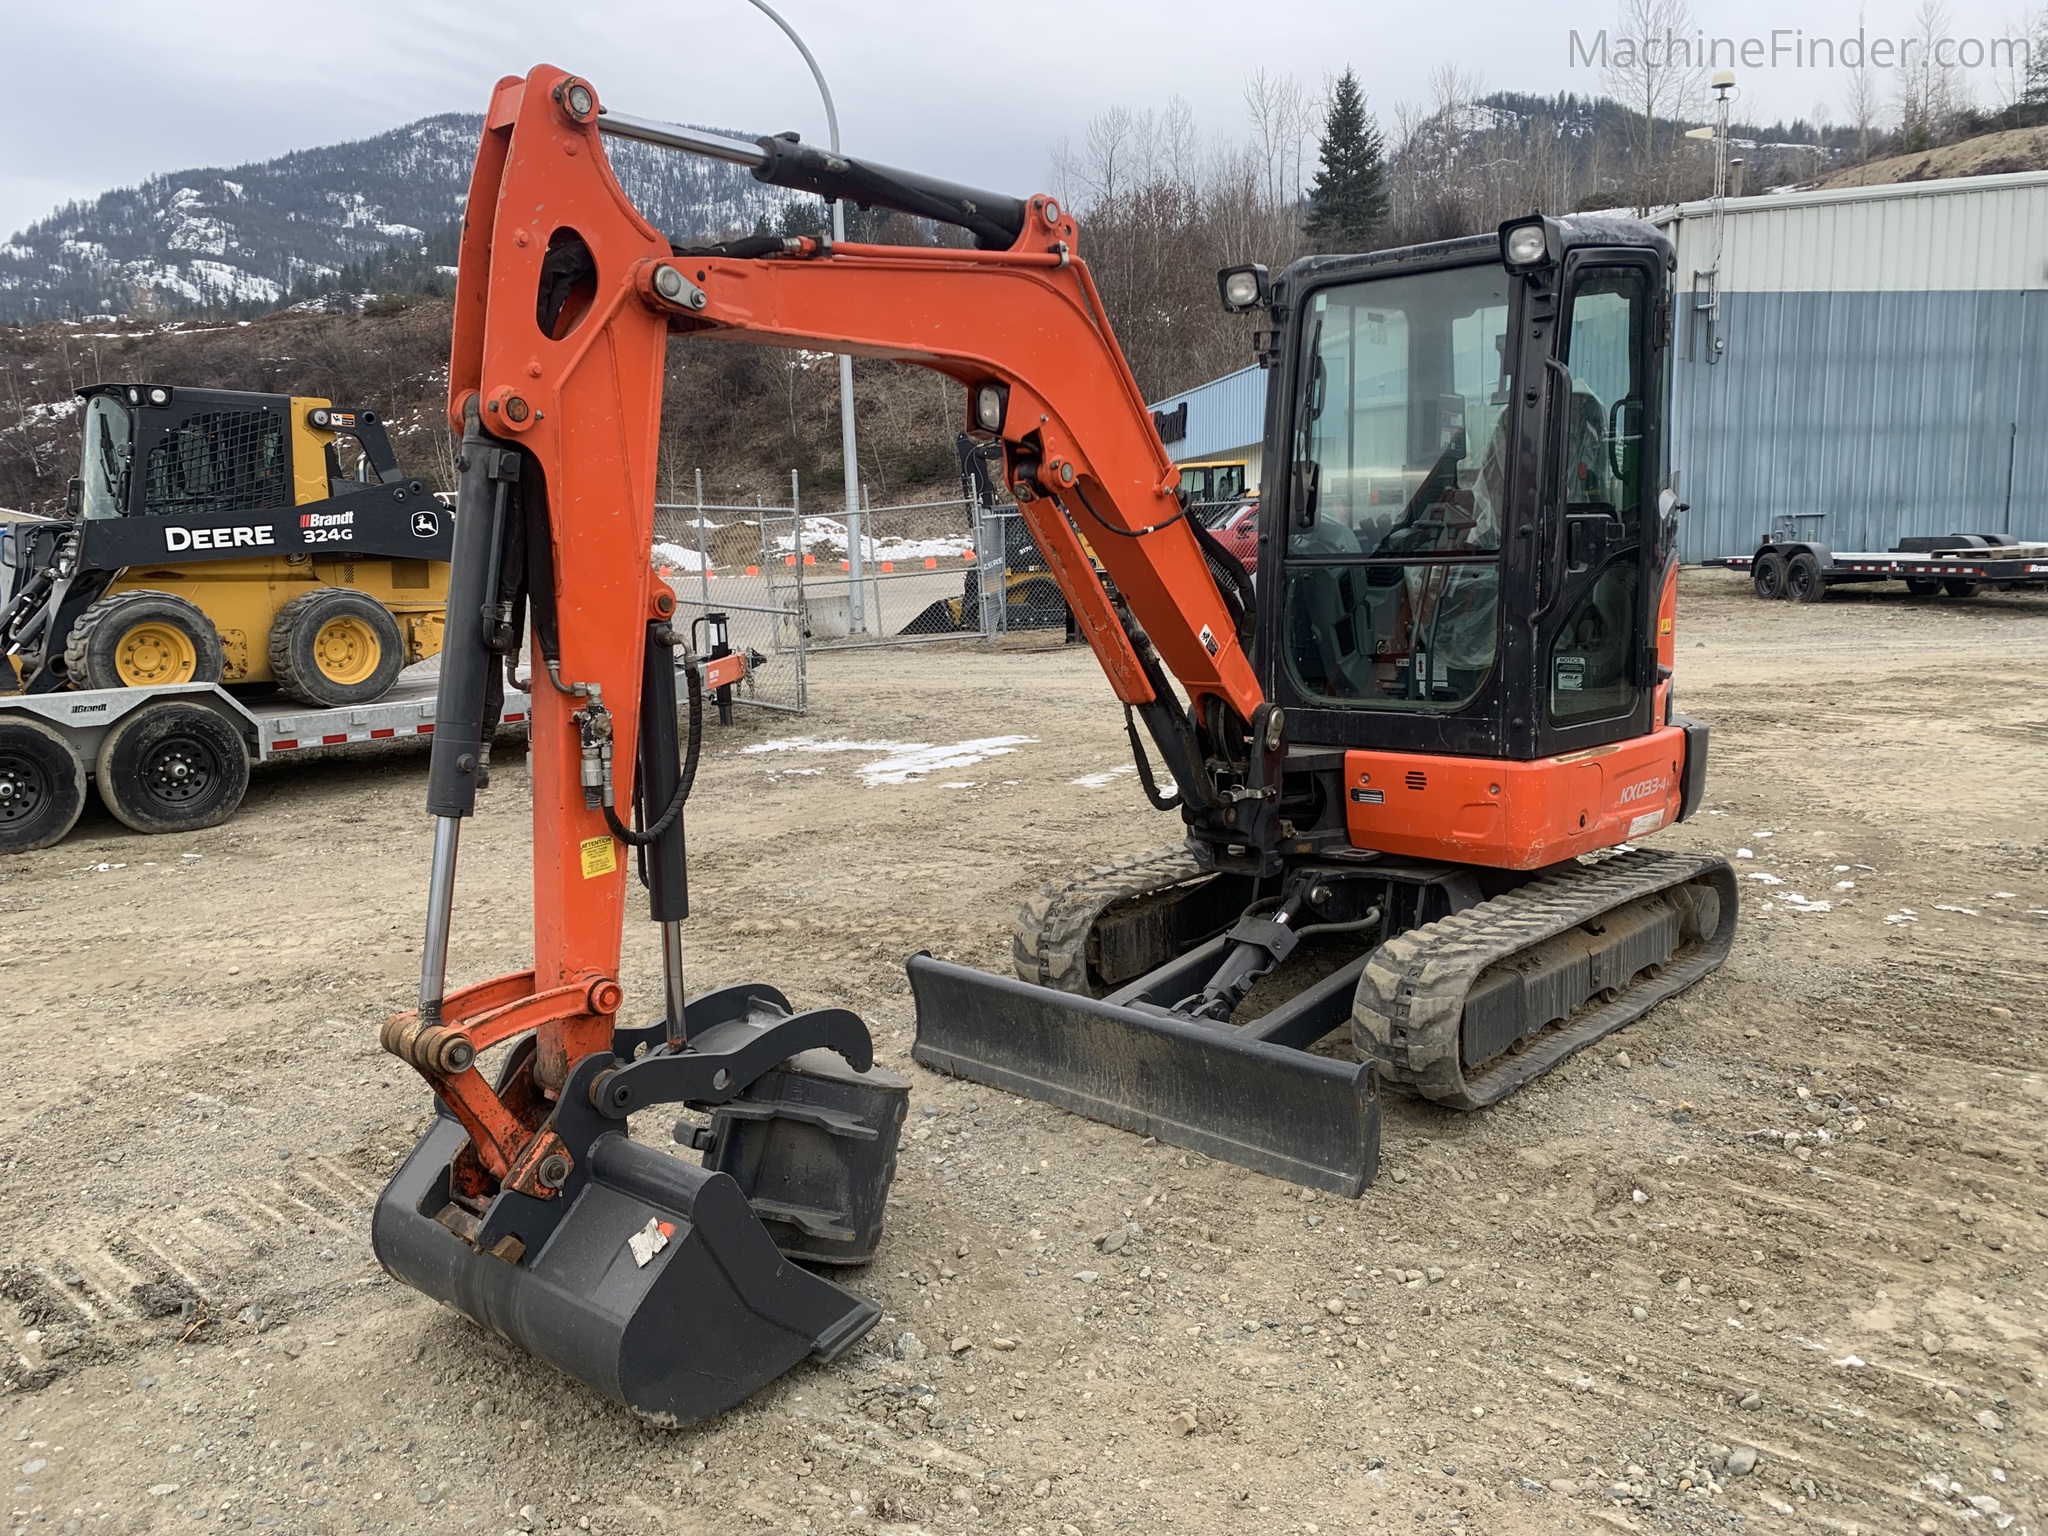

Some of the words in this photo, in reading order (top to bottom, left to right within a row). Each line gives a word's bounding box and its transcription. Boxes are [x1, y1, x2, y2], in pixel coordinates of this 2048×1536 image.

[310, 511, 354, 527] Brandt
[165, 525, 275, 552] DEERE
[303, 528, 353, 543] 324G
[581, 837, 612, 849] ATTENTION
